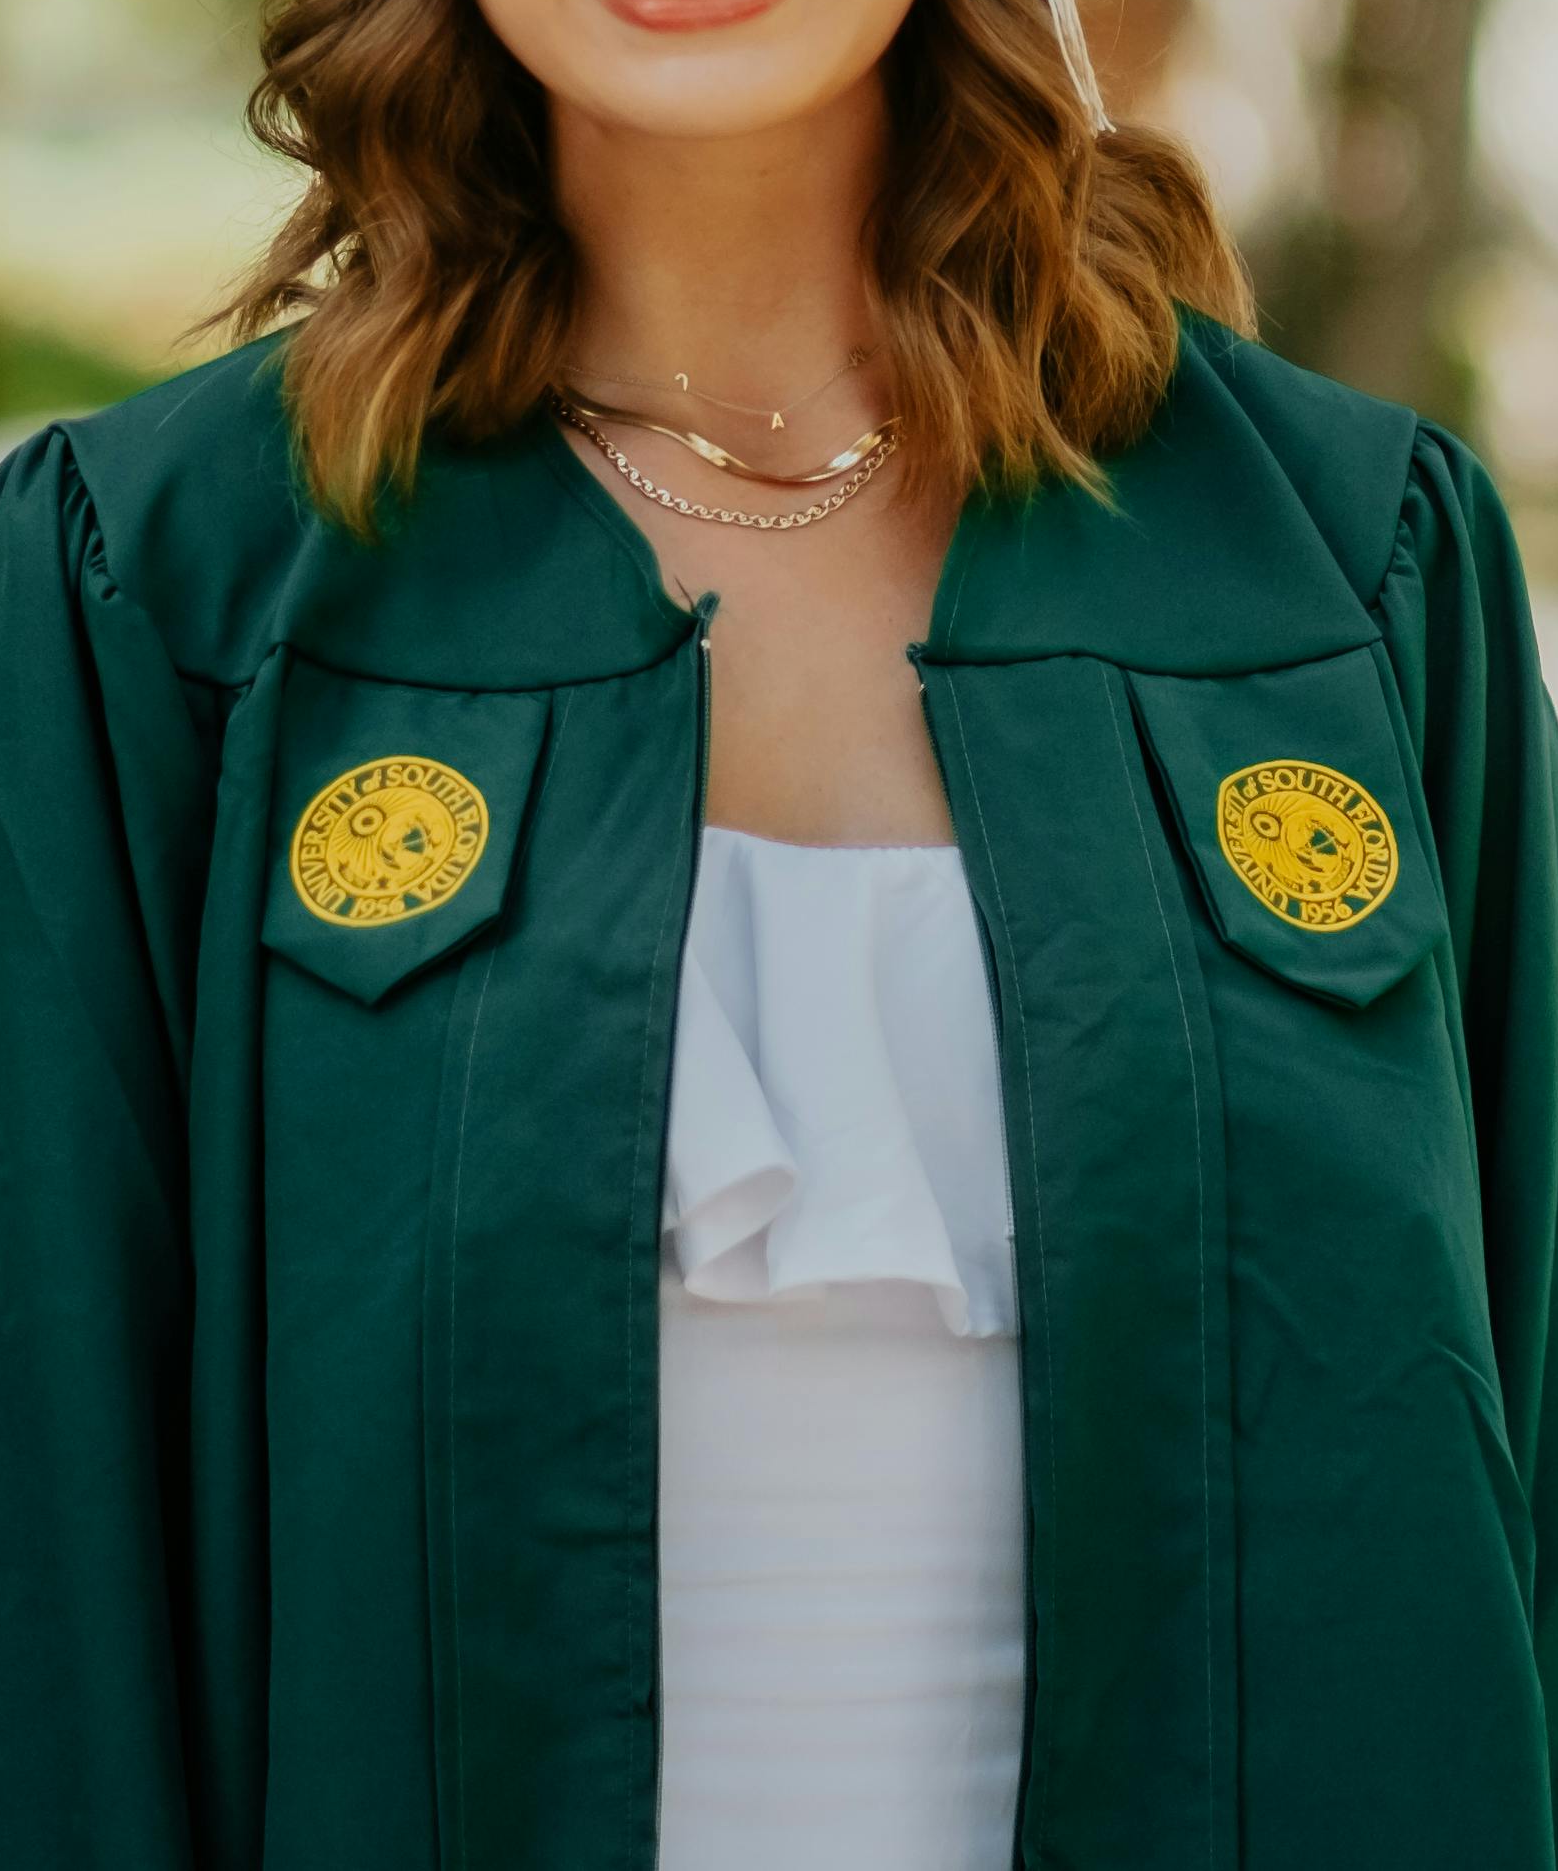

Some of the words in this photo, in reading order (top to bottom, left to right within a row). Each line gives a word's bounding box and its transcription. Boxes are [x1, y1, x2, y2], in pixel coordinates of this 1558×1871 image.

[386, 764, 472, 811] SOUTH
[1241, 776, 1257, 798] of
[1257, 768, 1353, 809] SOUTH
[300, 777, 362, 915] UNIVERSITY
[413, 804, 480, 901] FLORIDA
[1225, 785, 1289, 913] UNIVERSITY
[1345, 801, 1390, 901] FLORIDA
[1300, 897, 1353, 924] 1956
